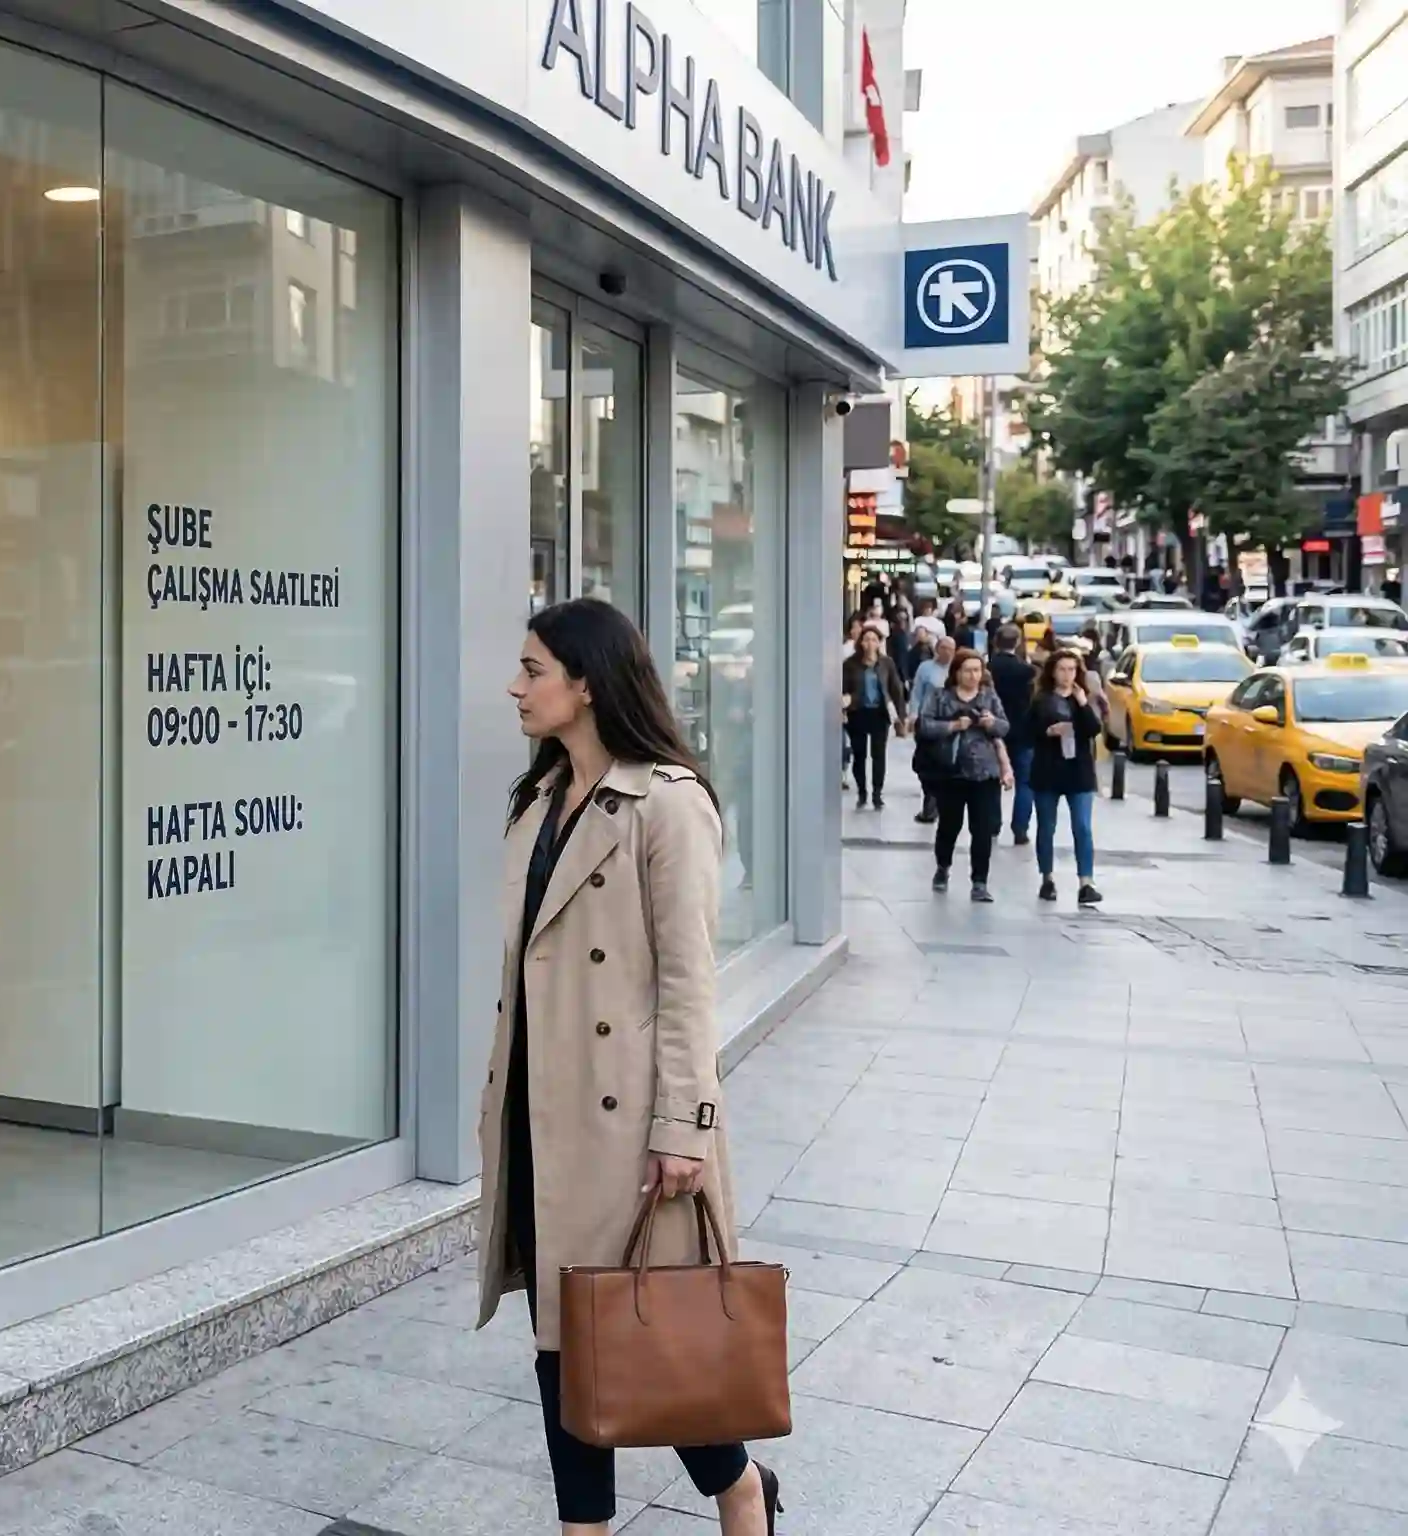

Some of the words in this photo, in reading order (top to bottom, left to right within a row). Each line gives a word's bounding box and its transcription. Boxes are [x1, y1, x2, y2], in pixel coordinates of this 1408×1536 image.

[541, 0, 729, 200] ALPHA
[737, 105, 838, 281] BANK
[147, 503, 212, 555] ŞUBE
[147, 563, 243, 611] ÇALIŞMA
[250, 566, 340, 608] SAATLERİ
[147, 653, 227, 692] HAFTA
[235, 644, 271, 700] İÇİ:
[147, 706, 220, 747] 09:00
[245, 703, 303, 742] 17:30
[147, 800, 227, 846] HAFTA
[234, 795, 303, 837] SONU:
[147, 850, 235, 899] KAPALI
